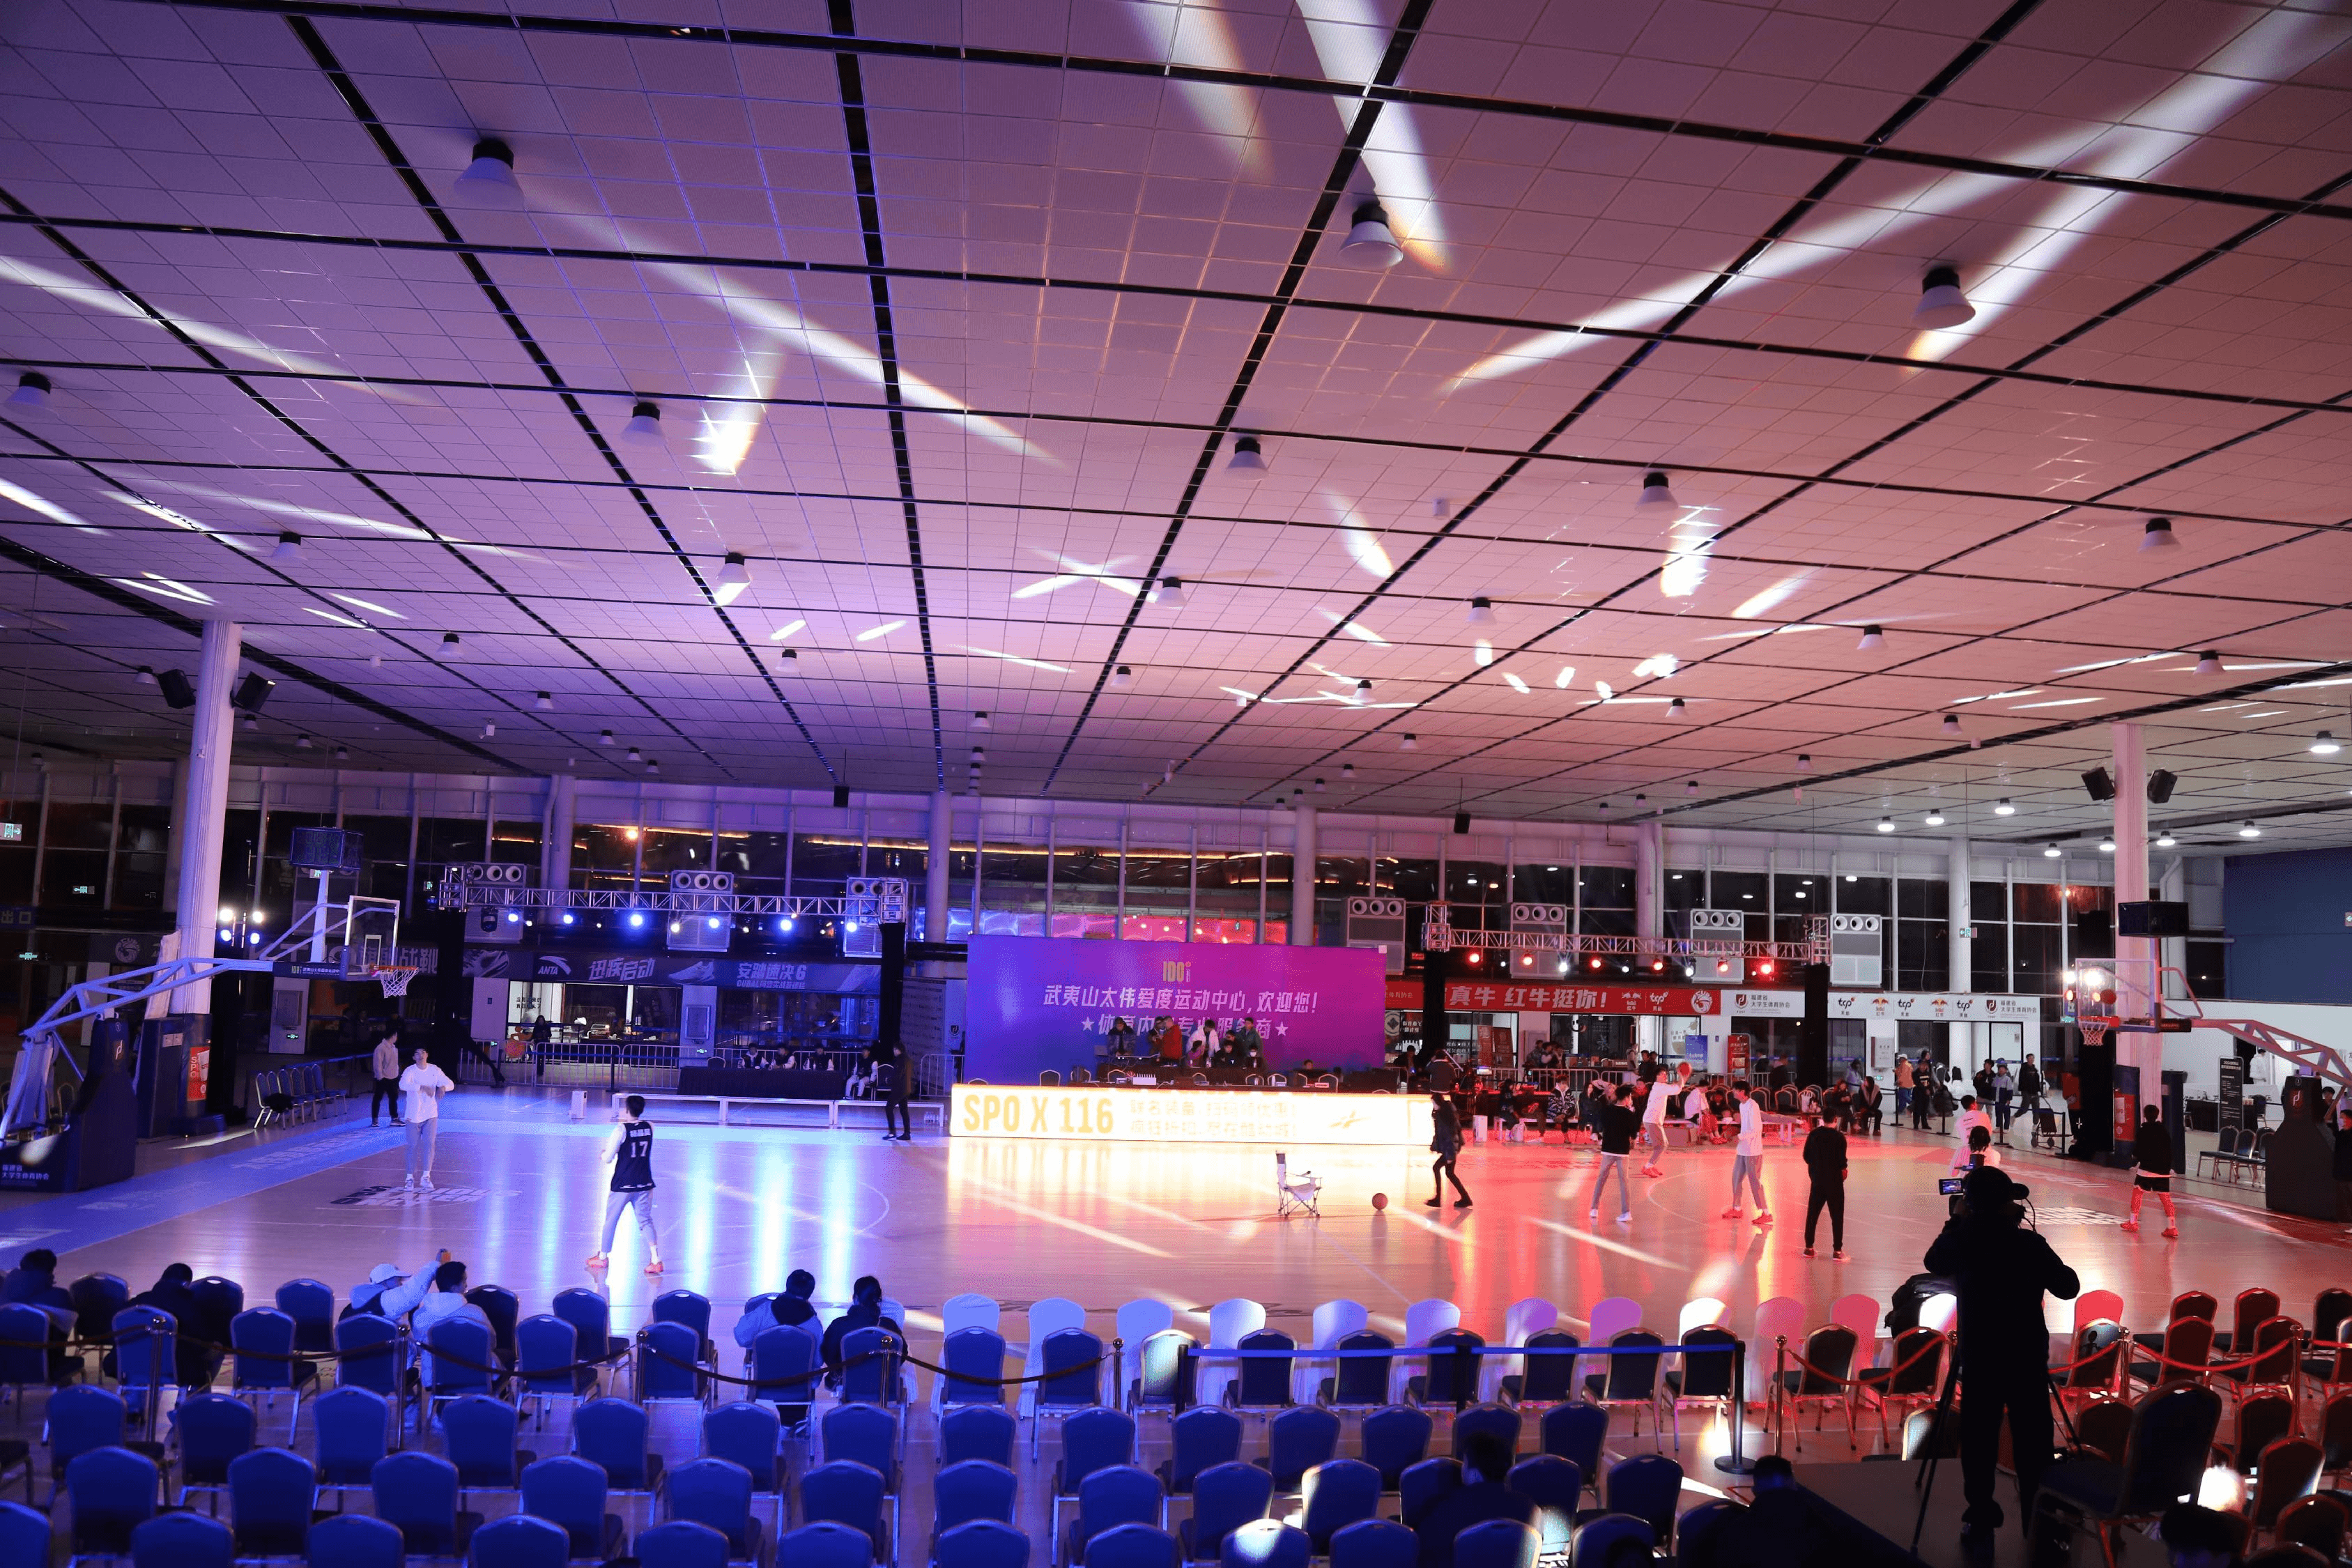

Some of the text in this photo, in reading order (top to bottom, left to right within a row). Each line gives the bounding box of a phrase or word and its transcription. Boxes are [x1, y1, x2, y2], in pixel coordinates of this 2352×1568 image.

[1, 910, 32, 925] 出口
[537, 966, 558, 975] ANTA
[1445, 985, 1607, 1009] 真牛 红牛挺你!
[1957, 1000, 1970, 1011] tcp
[963, 1094, 1114, 1134] SPO X 116
[631, 1141, 649, 1158] 17
